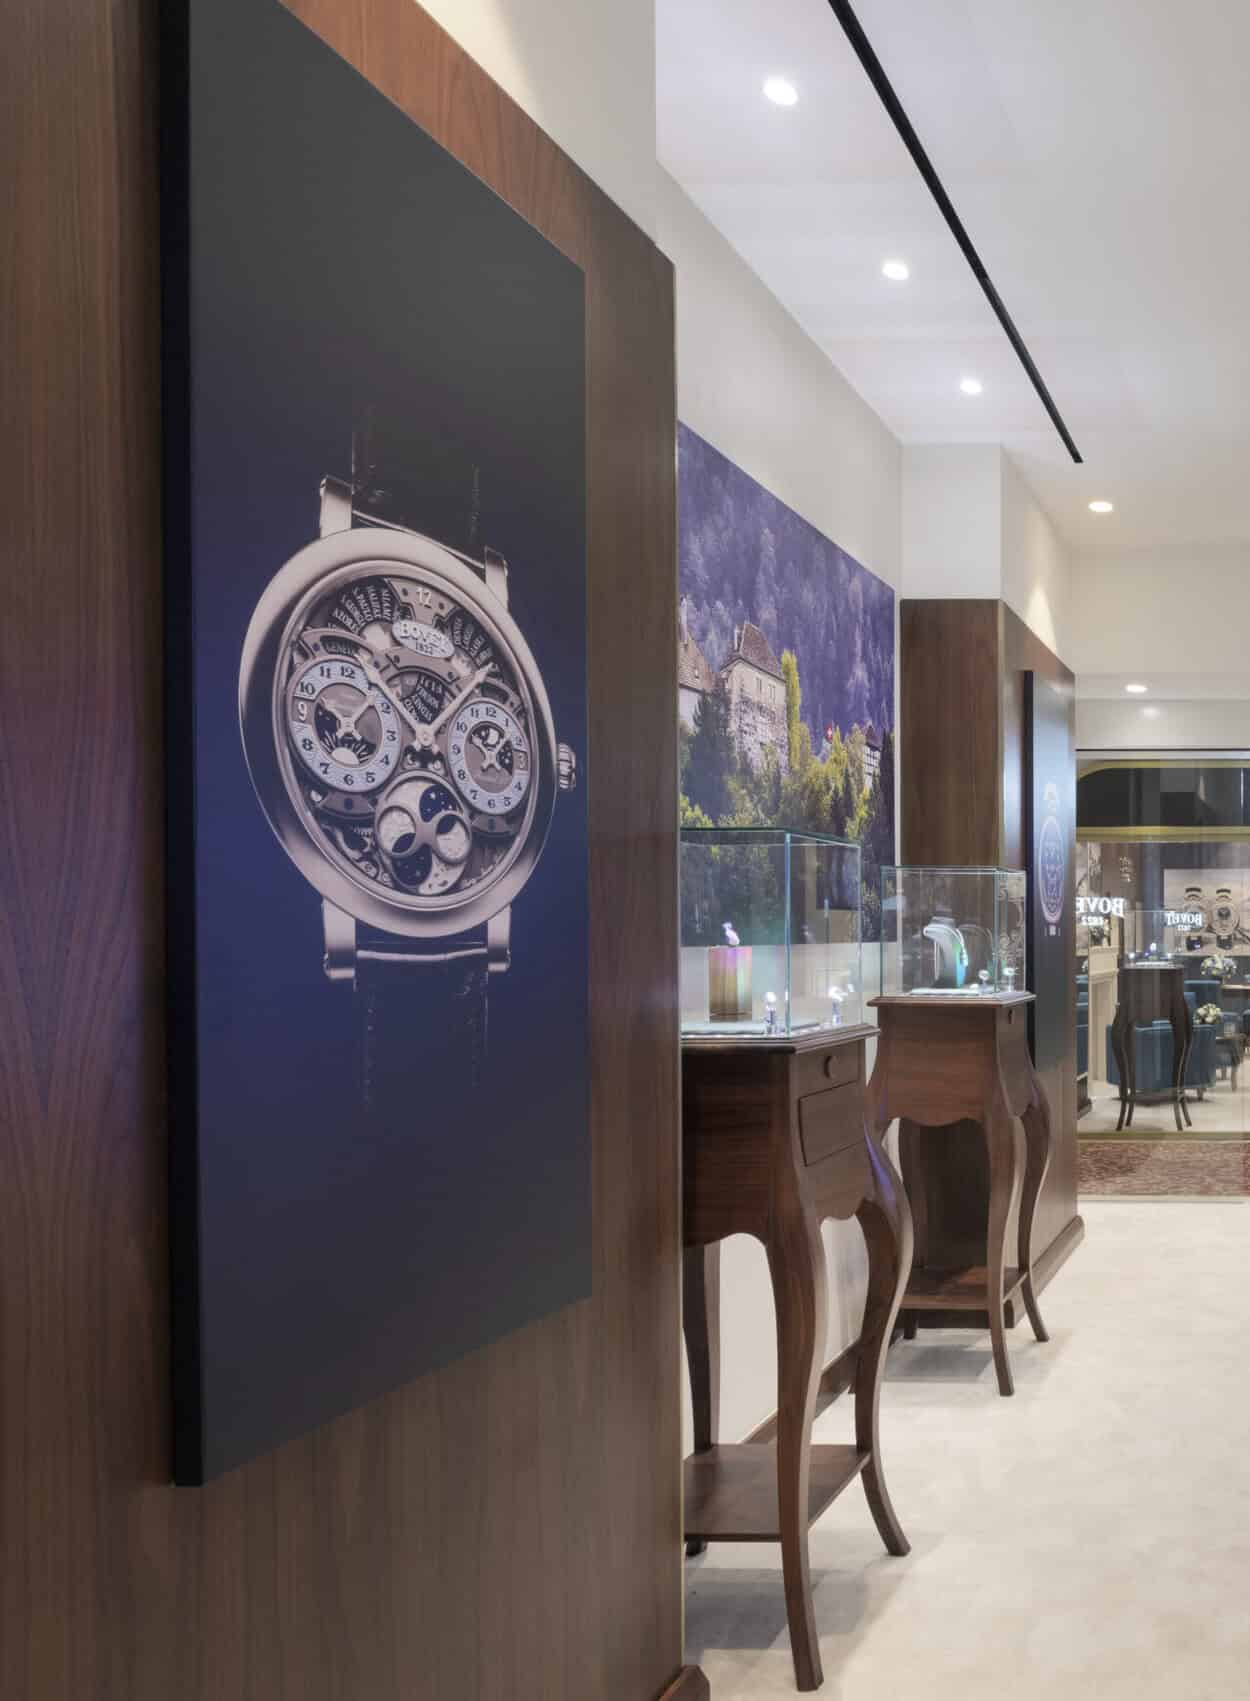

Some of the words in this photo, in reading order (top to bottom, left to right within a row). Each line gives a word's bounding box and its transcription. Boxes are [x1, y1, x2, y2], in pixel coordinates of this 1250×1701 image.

[416, 586, 433, 610] 12
[340, 666, 356, 679] 12
[299, 681, 316, 695] 10
[297, 700, 308, 721] 9
[302, 738, 313, 751] 8
[319, 763, 330, 775] 7
[343, 774, 354, 786] 6
